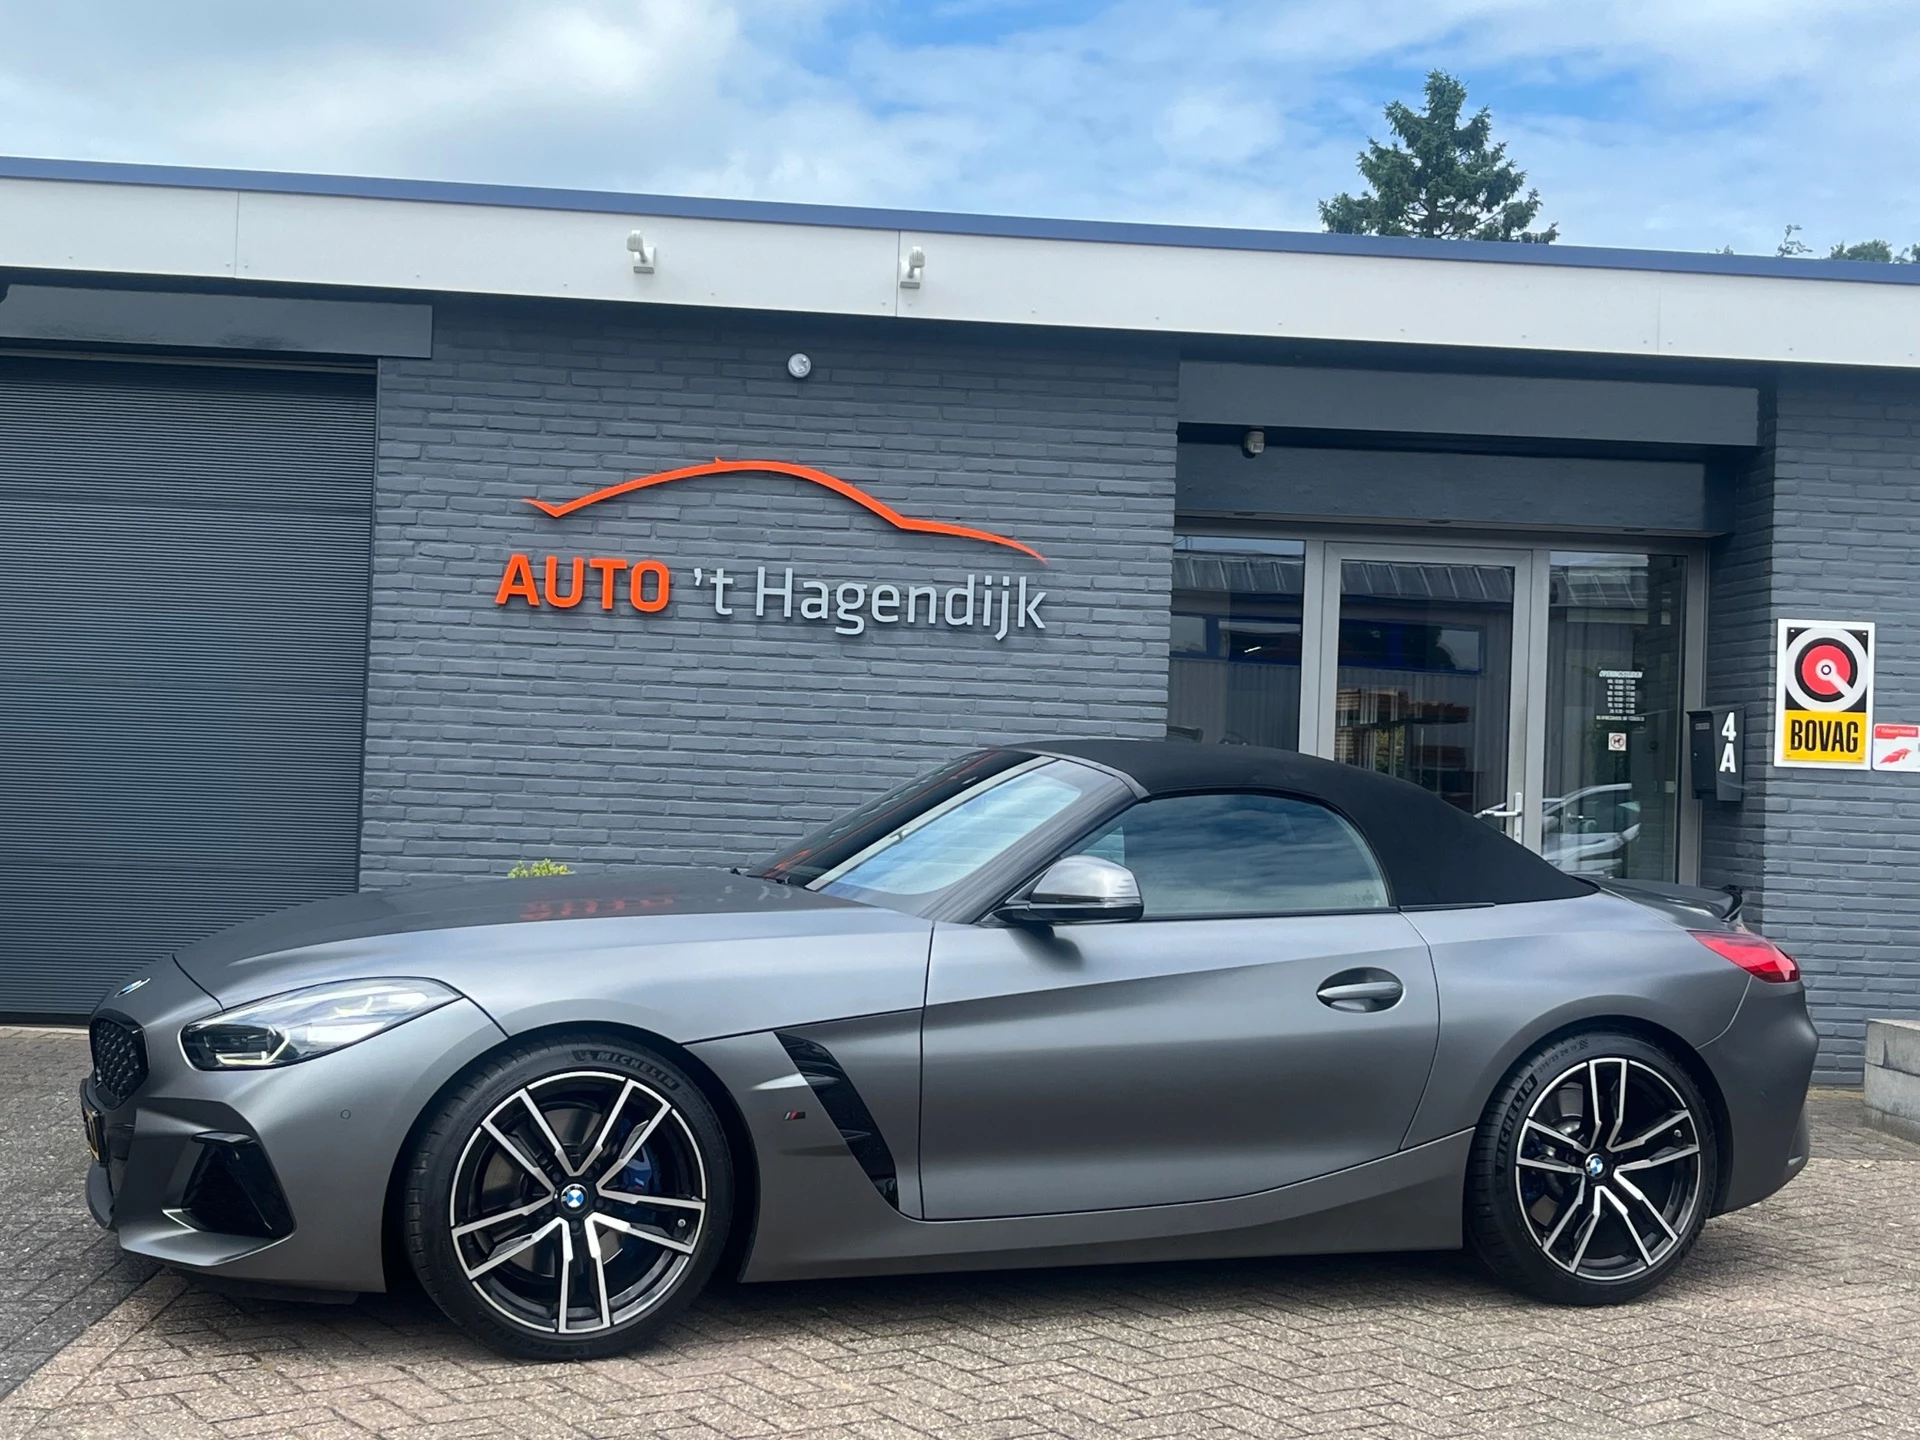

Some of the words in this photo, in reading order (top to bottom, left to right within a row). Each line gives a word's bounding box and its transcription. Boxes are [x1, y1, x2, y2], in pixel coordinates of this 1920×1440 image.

[495, 554, 670, 612] AUTO
[755, 566, 1046, 641] Hagendijk
[1721, 711, 1737, 742] 4
[1790, 719, 1859, 753] BOVAG
[1719, 743, 1737, 773] A
[597, 1051, 676, 1088] MICHELIN
[1496, 1078, 1534, 1168] MICHELIN
